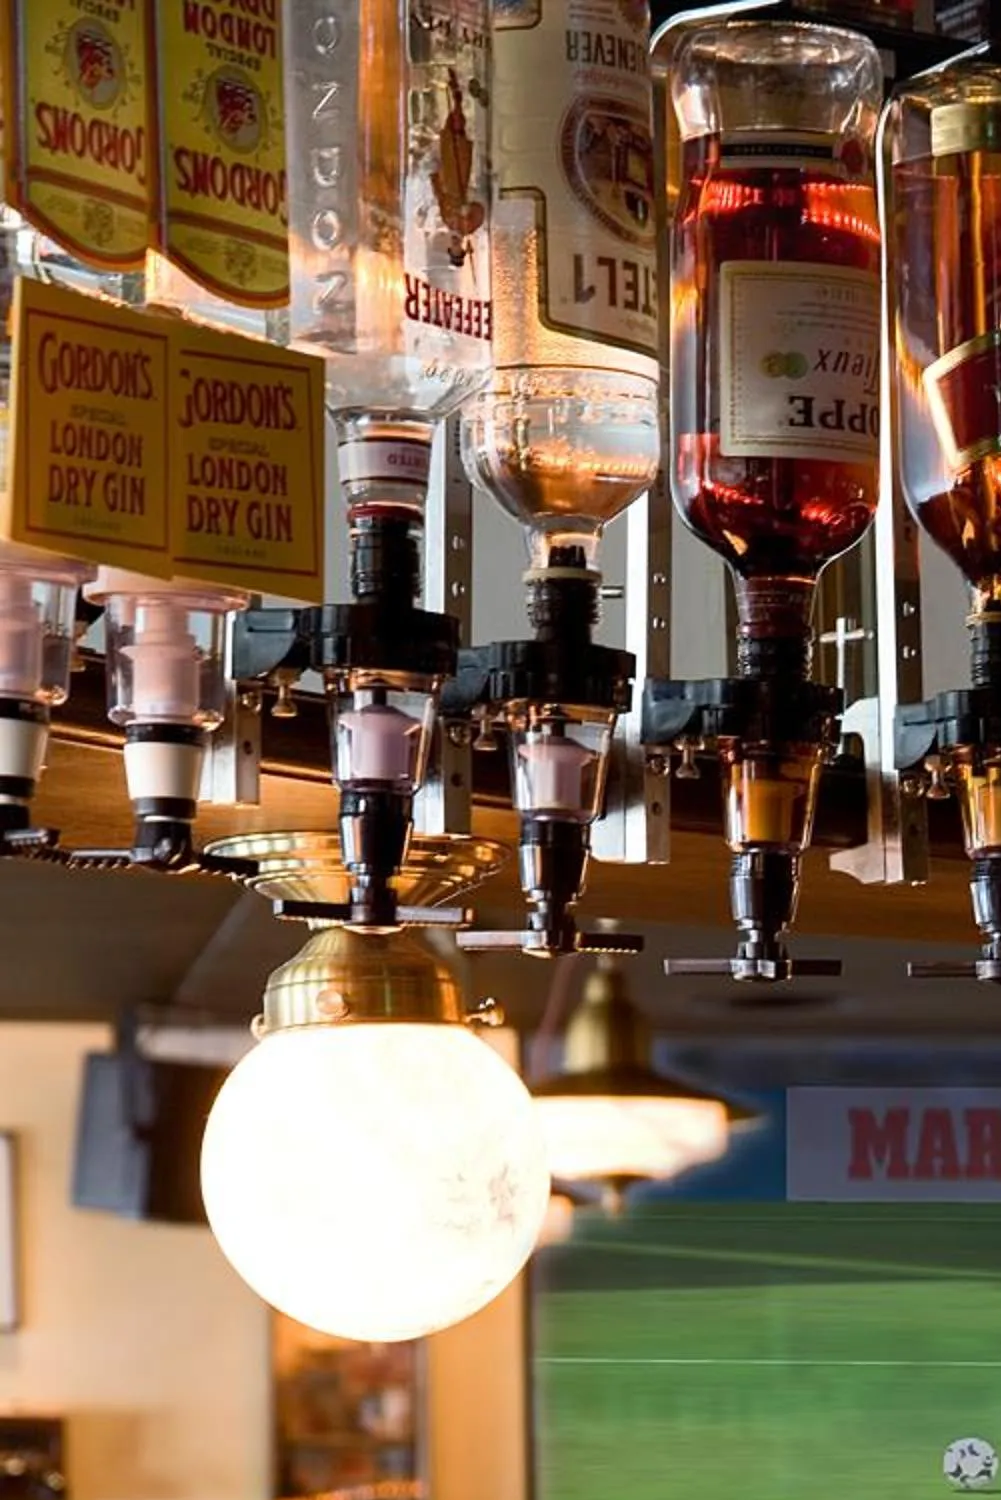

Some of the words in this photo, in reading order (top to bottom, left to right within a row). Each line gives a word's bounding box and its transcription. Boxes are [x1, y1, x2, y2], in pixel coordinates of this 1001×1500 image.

[182, 1, 277, 61] LONDON
[312, 15, 346, 316] ONDON
[404, 272, 493, 342] EEFEATER
[37, 331, 154, 401] GORDON'S
[788, 396, 880, 439] OPPE
[50, 420, 143, 469] LONDON
[47, 464, 97, 507] DRY
[103, 472, 146, 516] GIN
[186, 452, 288, 496] LONDON
[186, 494, 239, 536] DRY
[245, 502, 293, 543] GIN
